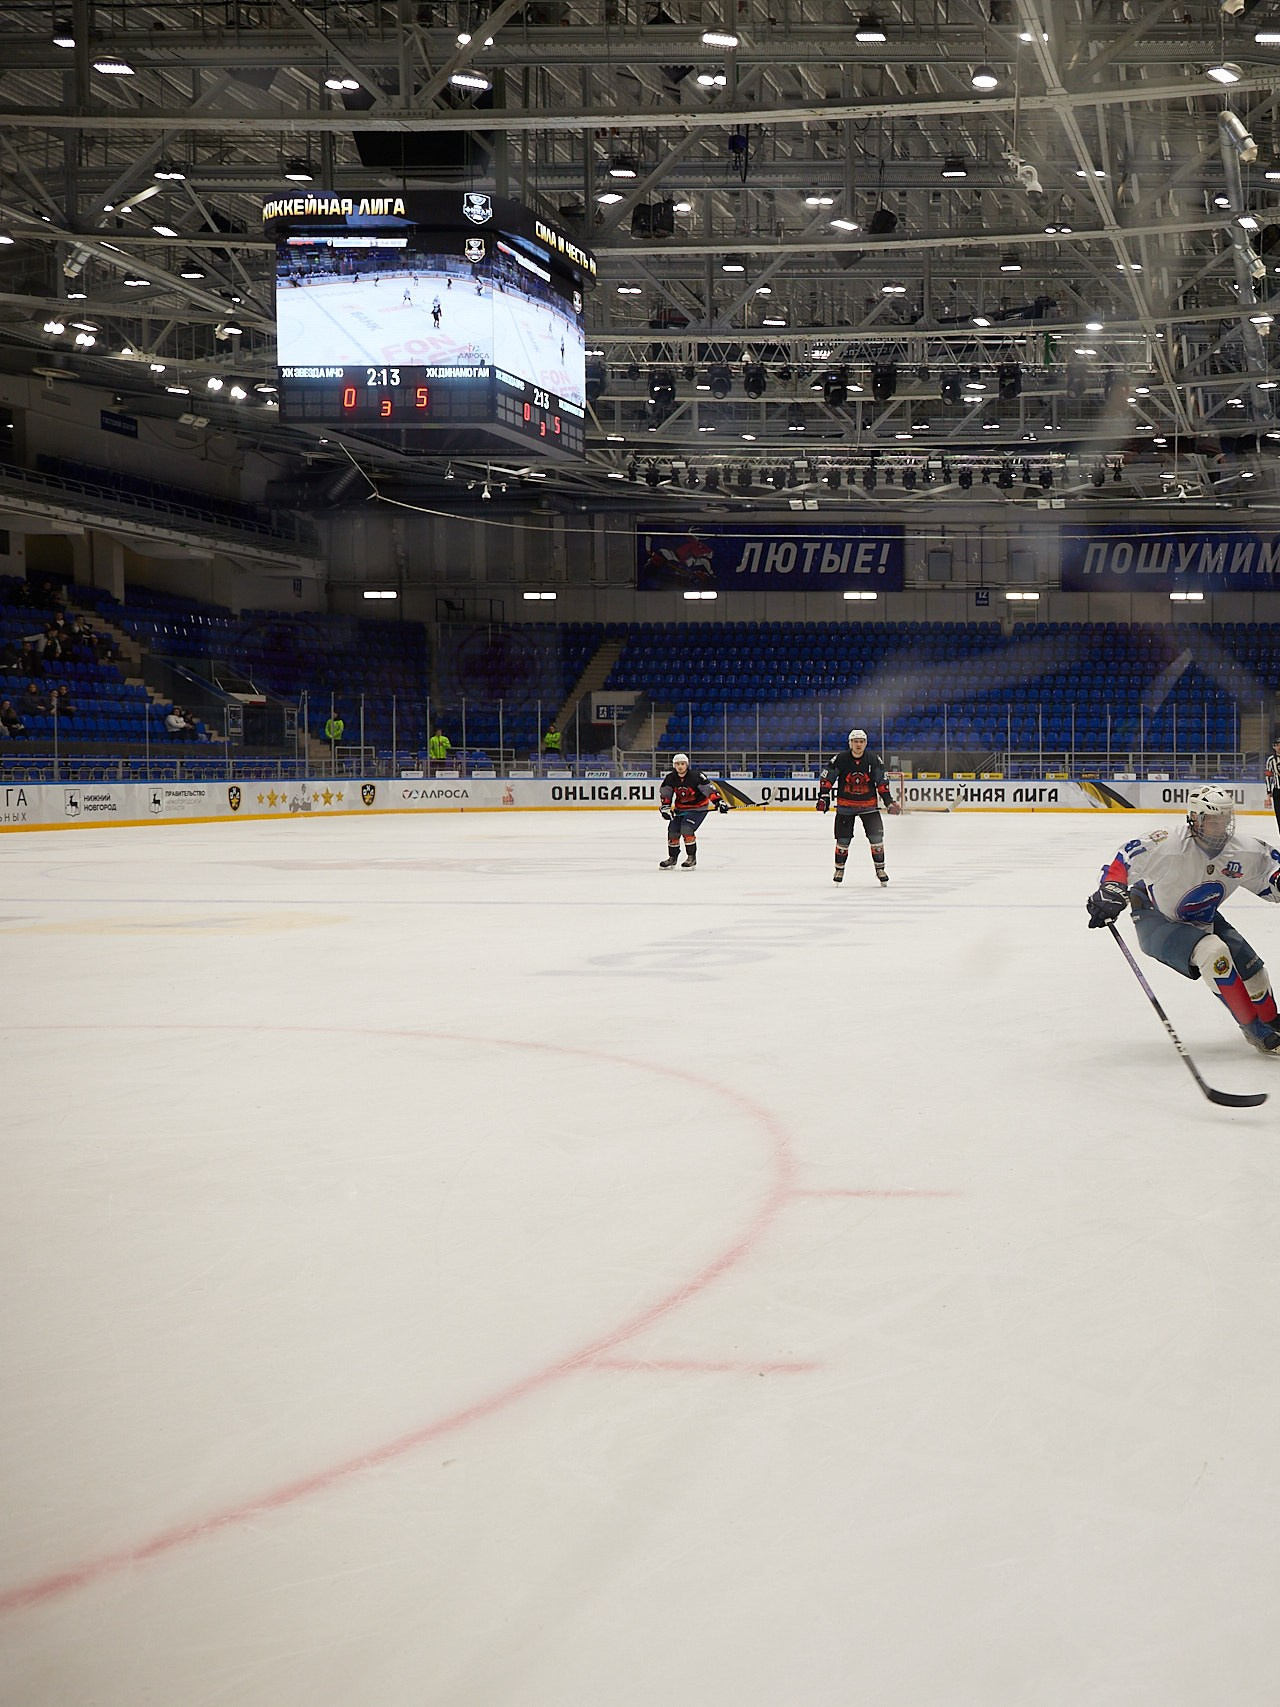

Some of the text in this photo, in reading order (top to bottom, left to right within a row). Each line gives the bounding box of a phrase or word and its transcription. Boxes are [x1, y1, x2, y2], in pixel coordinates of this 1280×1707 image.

[358, 198, 405, 215] ЛИГА
[535, 220, 557, 249] СИЛА
[557, 236, 565, 254] И
[565, 241, 589, 270] ЧЕСТЬ
[282, 367, 294, 378] ХК
[294, 367, 325, 379] ЗВЕЗДА
[366, 367, 400, 386] 2:13
[425, 367, 438, 378] ХК
[344, 388, 356, 407] 0
[416, 388, 428, 407] 5
[380, 400, 392, 416] 3
[524, 402, 531, 421] 0
[540, 421, 546, 436] 3
[554, 416, 560, 434] 5
[735, 542, 891, 574] ЛЮТЫЕ!
[83, 792, 111, 802] НИЖНИЙ
[420, 789, 469, 799] АЛРОСА
[551, 786, 655, 801] OHLIGA.RU
[896, 784, 1005, 802] ХОККЕЙНАЯ
[1013, 788, 1059, 802] ЛИГА
[83, 803, 117, 811] НОВГОРОД
